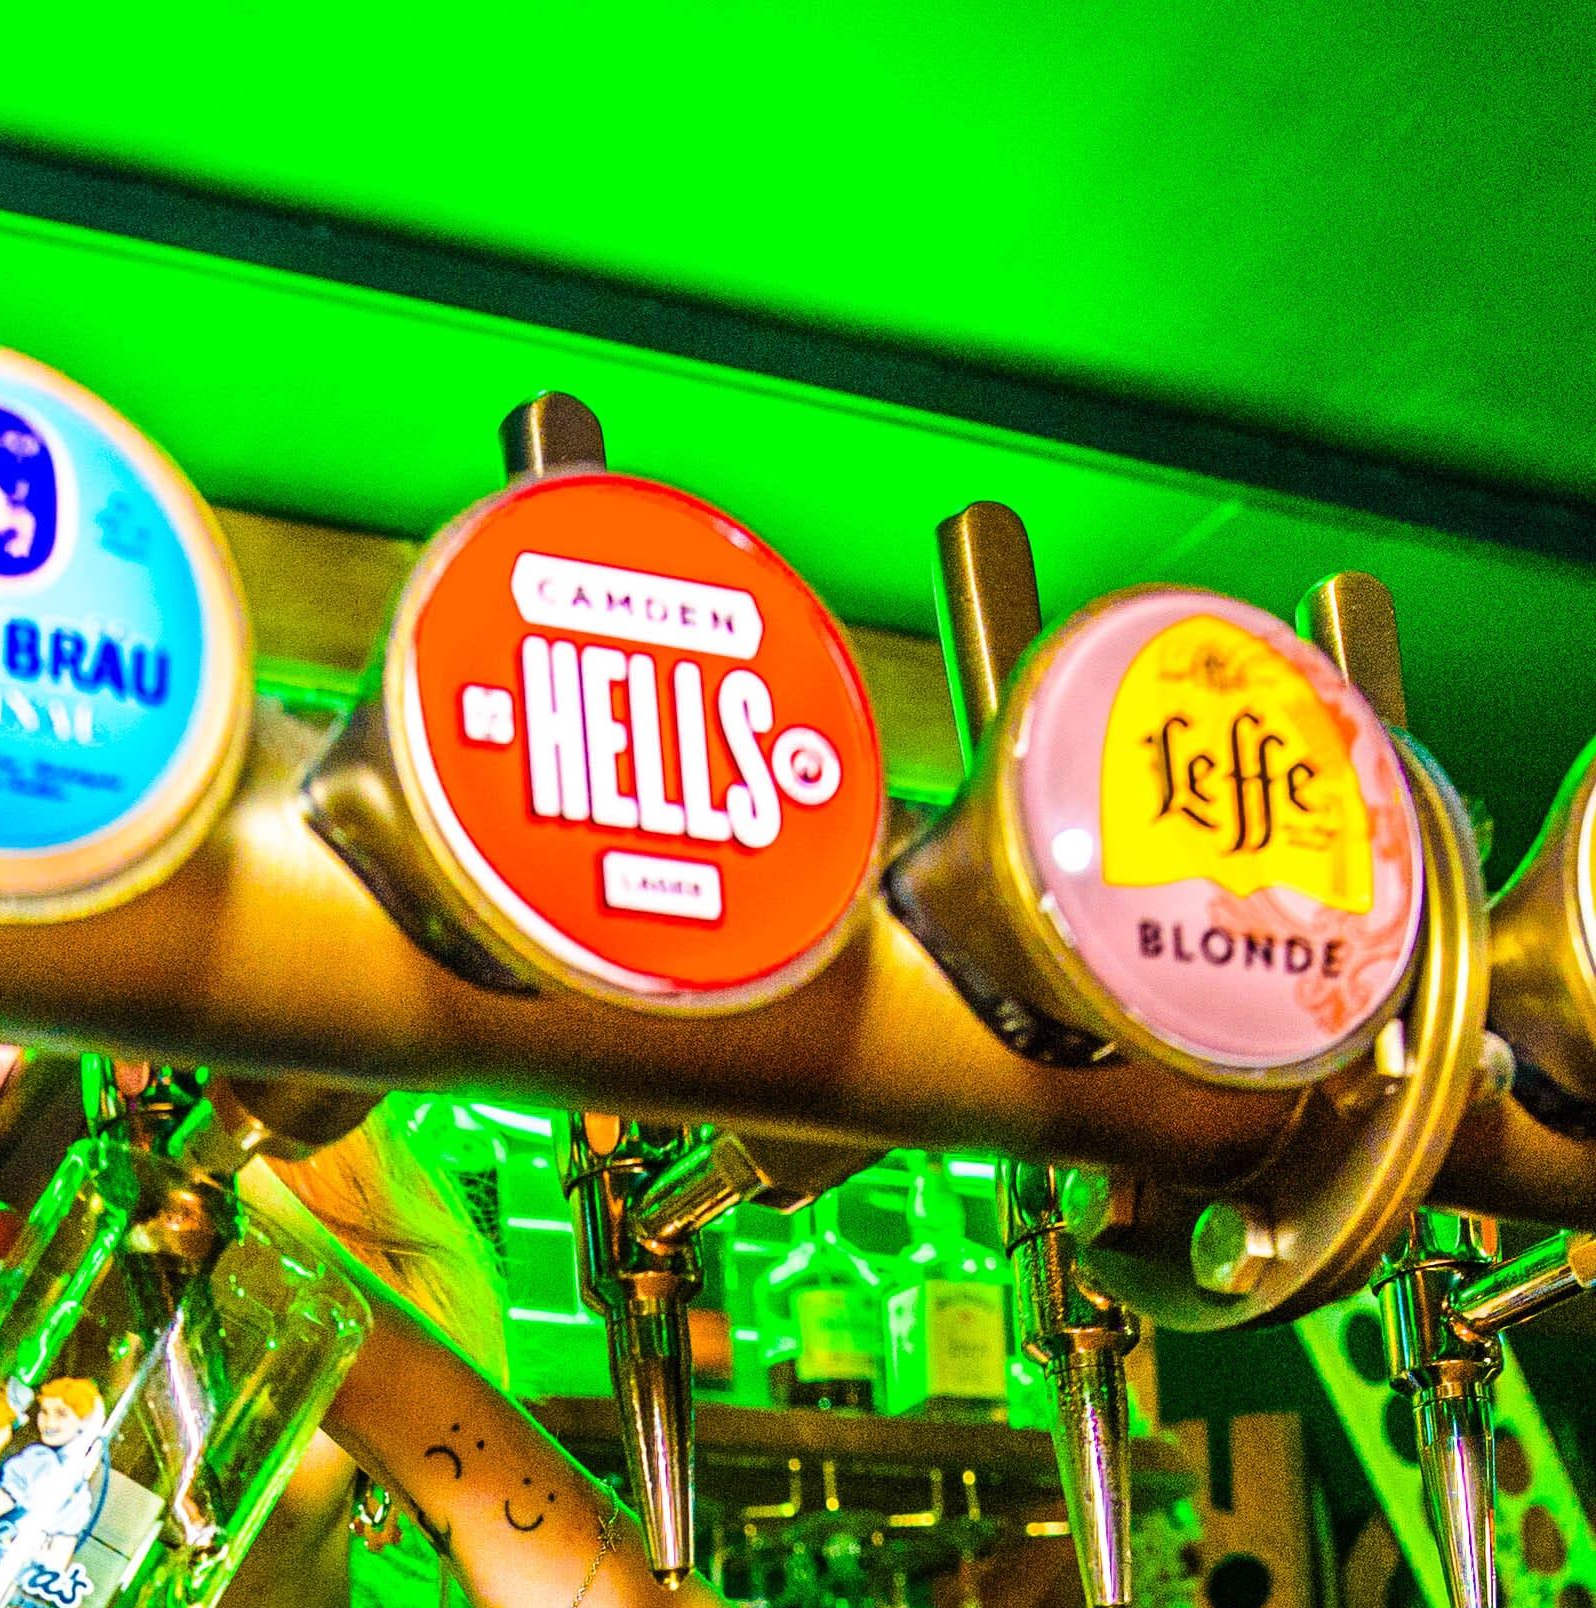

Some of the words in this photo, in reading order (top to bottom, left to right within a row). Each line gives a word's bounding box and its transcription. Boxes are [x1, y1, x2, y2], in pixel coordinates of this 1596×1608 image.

[536, 576, 736, 636] CAMDEN
[521, 634, 782, 849] HELLS
[1145, 712, 1317, 858] Leffe
[1137, 916, 1344, 978] BLONDE
